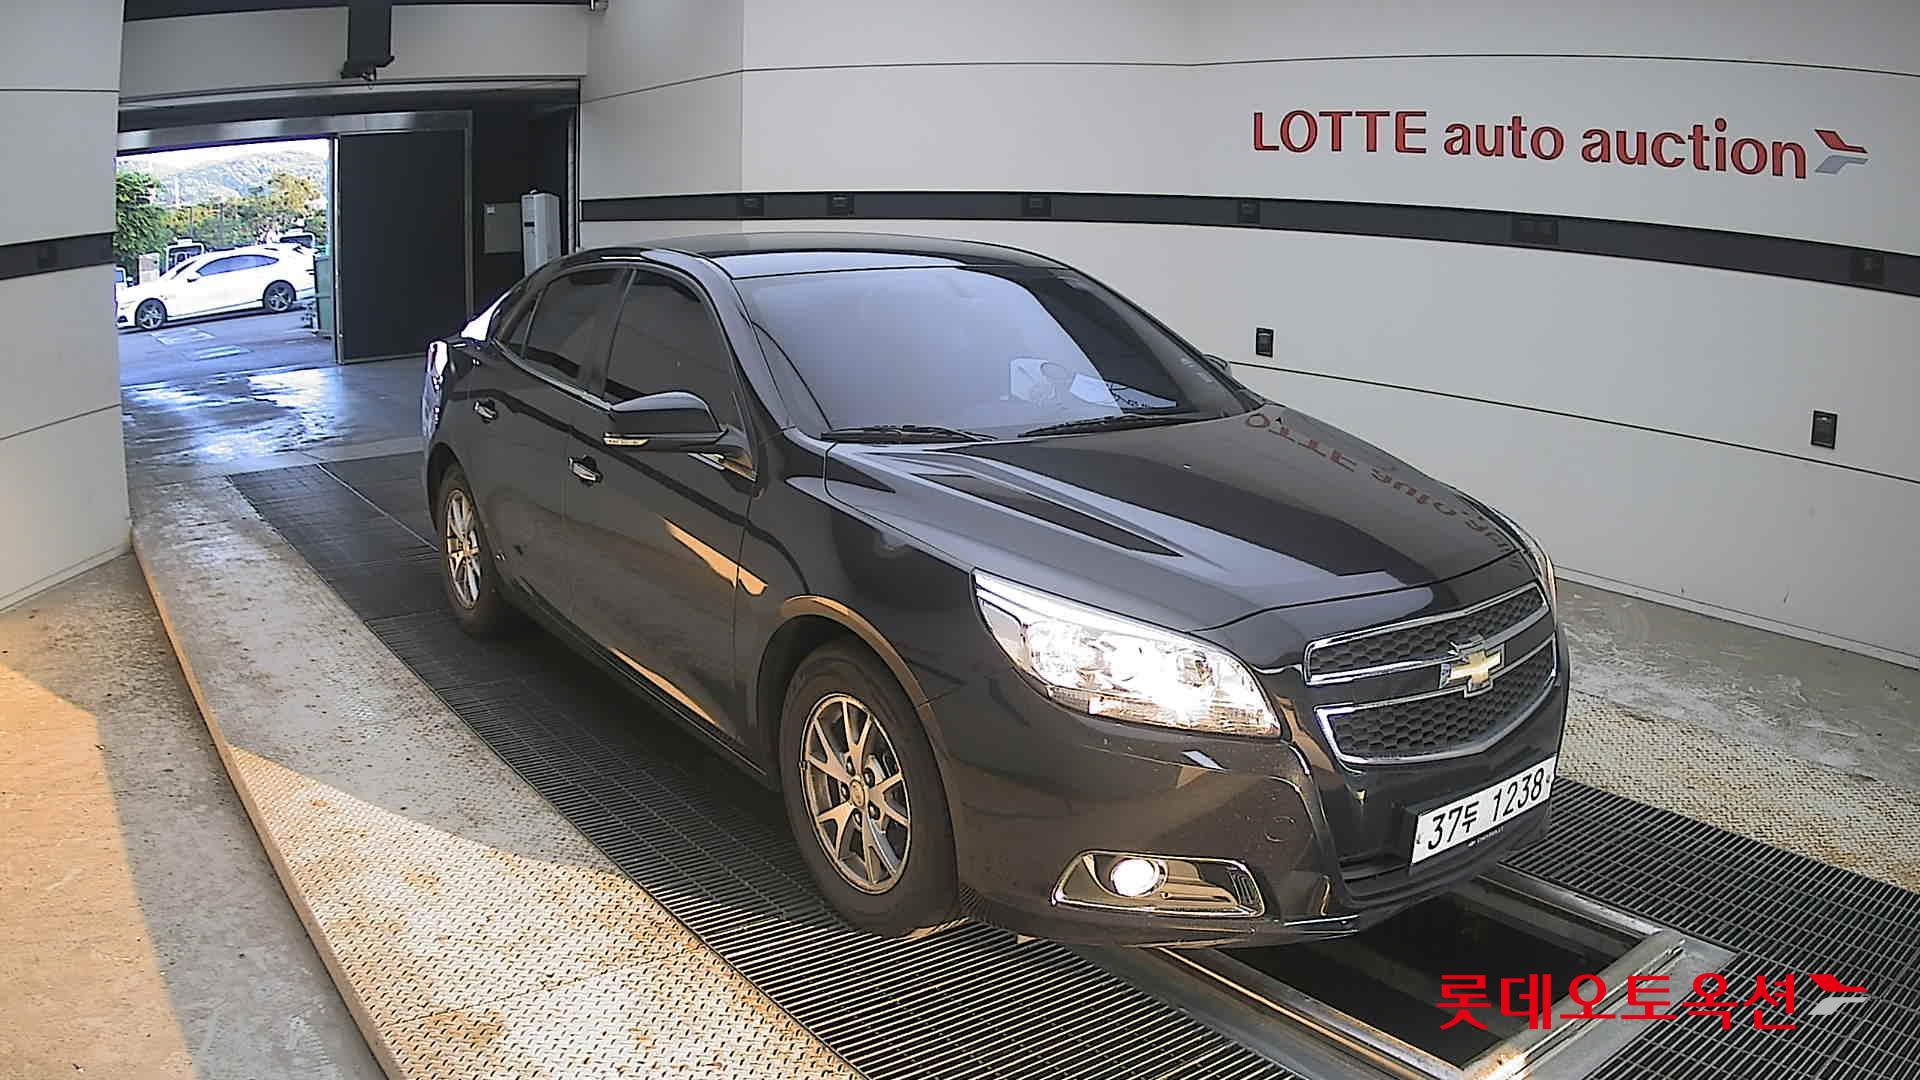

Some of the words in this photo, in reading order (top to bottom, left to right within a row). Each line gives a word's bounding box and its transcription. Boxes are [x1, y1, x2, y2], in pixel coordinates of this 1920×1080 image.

[1253, 110, 1427, 154] LOTTE
[1443, 115, 1565, 161] auto
[1581, 118, 1808, 179] auction
[1427, 801, 1480, 850] 37두
[1493, 767, 1545, 822] 1238
